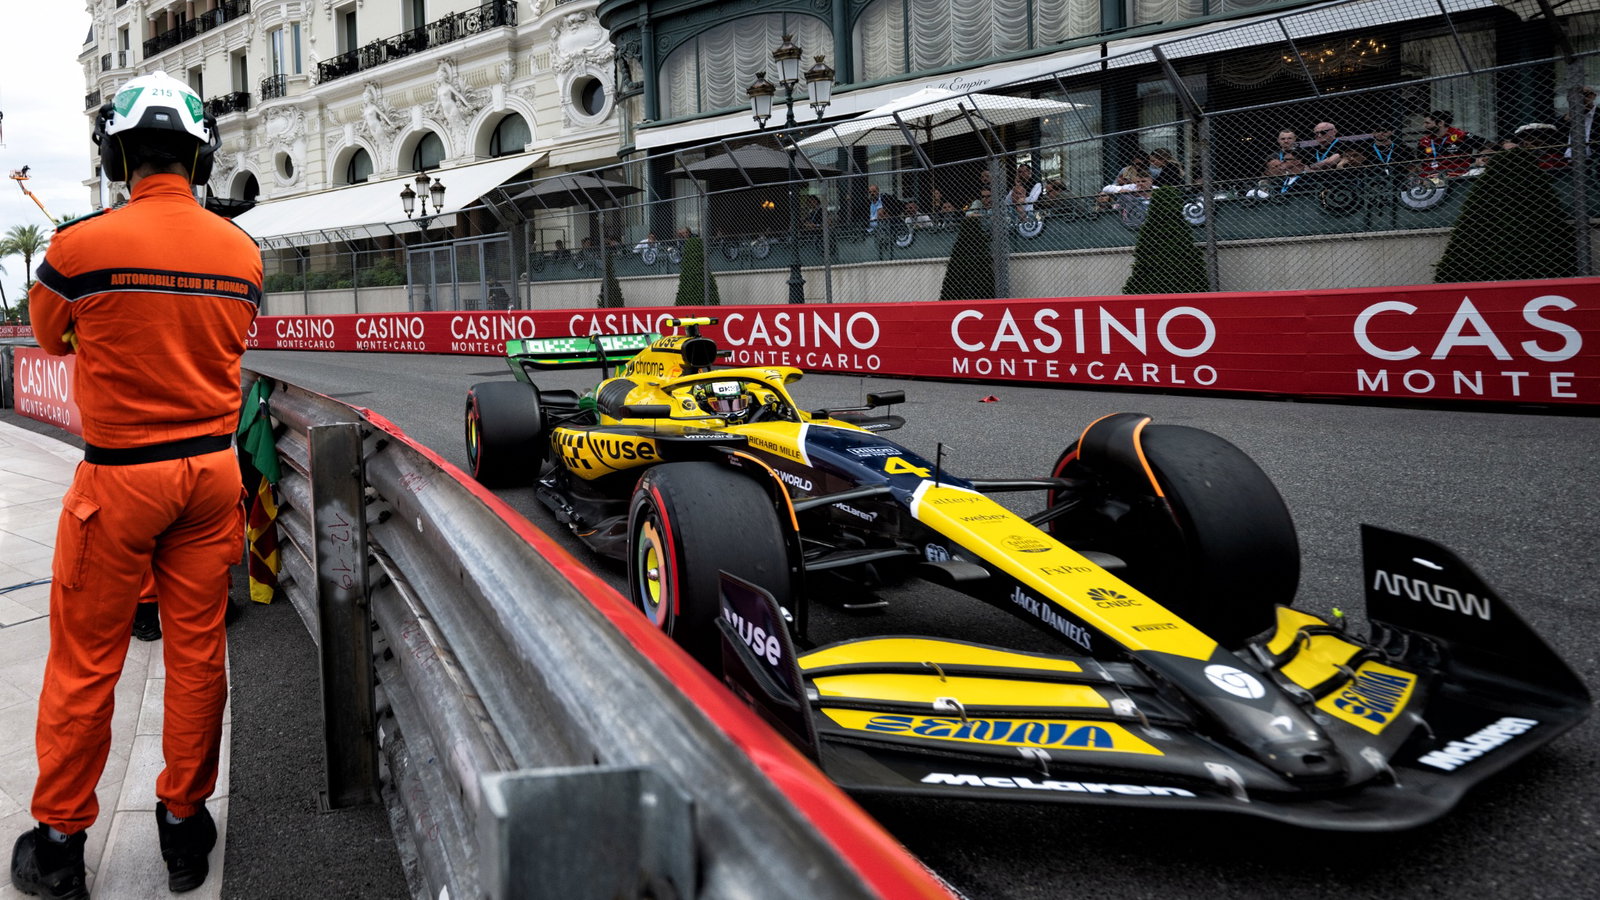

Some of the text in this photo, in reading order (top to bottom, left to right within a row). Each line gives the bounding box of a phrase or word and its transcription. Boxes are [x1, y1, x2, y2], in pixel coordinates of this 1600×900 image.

[152, 88, 173, 97] 215
[949, 77, 991, 92] Empire
[111, 273, 249, 296] AUTOMOBILE CLUB DE MONACO
[275, 318, 335, 339] CASINO
[356, 316, 425, 340] CASINO
[450, 315, 537, 340] CASINO
[568, 313, 679, 338] CASINO
[723, 310, 881, 350] CASINO
[951, 305, 1217, 358] CASINO
[1353, 294, 1583, 362] CAS
[245, 339, 259, 348] RLO
[276, 339, 336, 349] MONTE CARLO
[356, 340, 426, 351] MONTE CARLO
[451, 341, 491, 353] MONTE
[529, 339, 577, 353] OKX
[600, 335, 645, 351] OKX
[635, 360, 665, 378] chrome
[725, 350, 881, 370] MONTE CARLO
[19, 356, 69, 404] CASINO
[952, 357, 1218, 386] MONTE CARLO
[1356, 368, 1578, 398] MONTE
[20, 397, 71, 426] MONTE CARLO
[748, 435, 802, 460] RICHARD MILLE
[884, 456, 932, 478] 4
[779, 470, 813, 491] WORLD
[933, 495, 983, 505] alteryx
[832, 502, 874, 522] McLaren
[959, 513, 1009, 522] webex
[1039, 565, 1093, 576] FxPro
[1095, 598, 1143, 610] CNBC
[1010, 585, 1094, 652] JACK DANIEL'S
[1334, 670, 1412, 724] SENNA
[864, 714, 1114, 749] SENNA
[1417, 716, 1540, 772] McLaren
[919, 772, 1198, 798] McLaren
